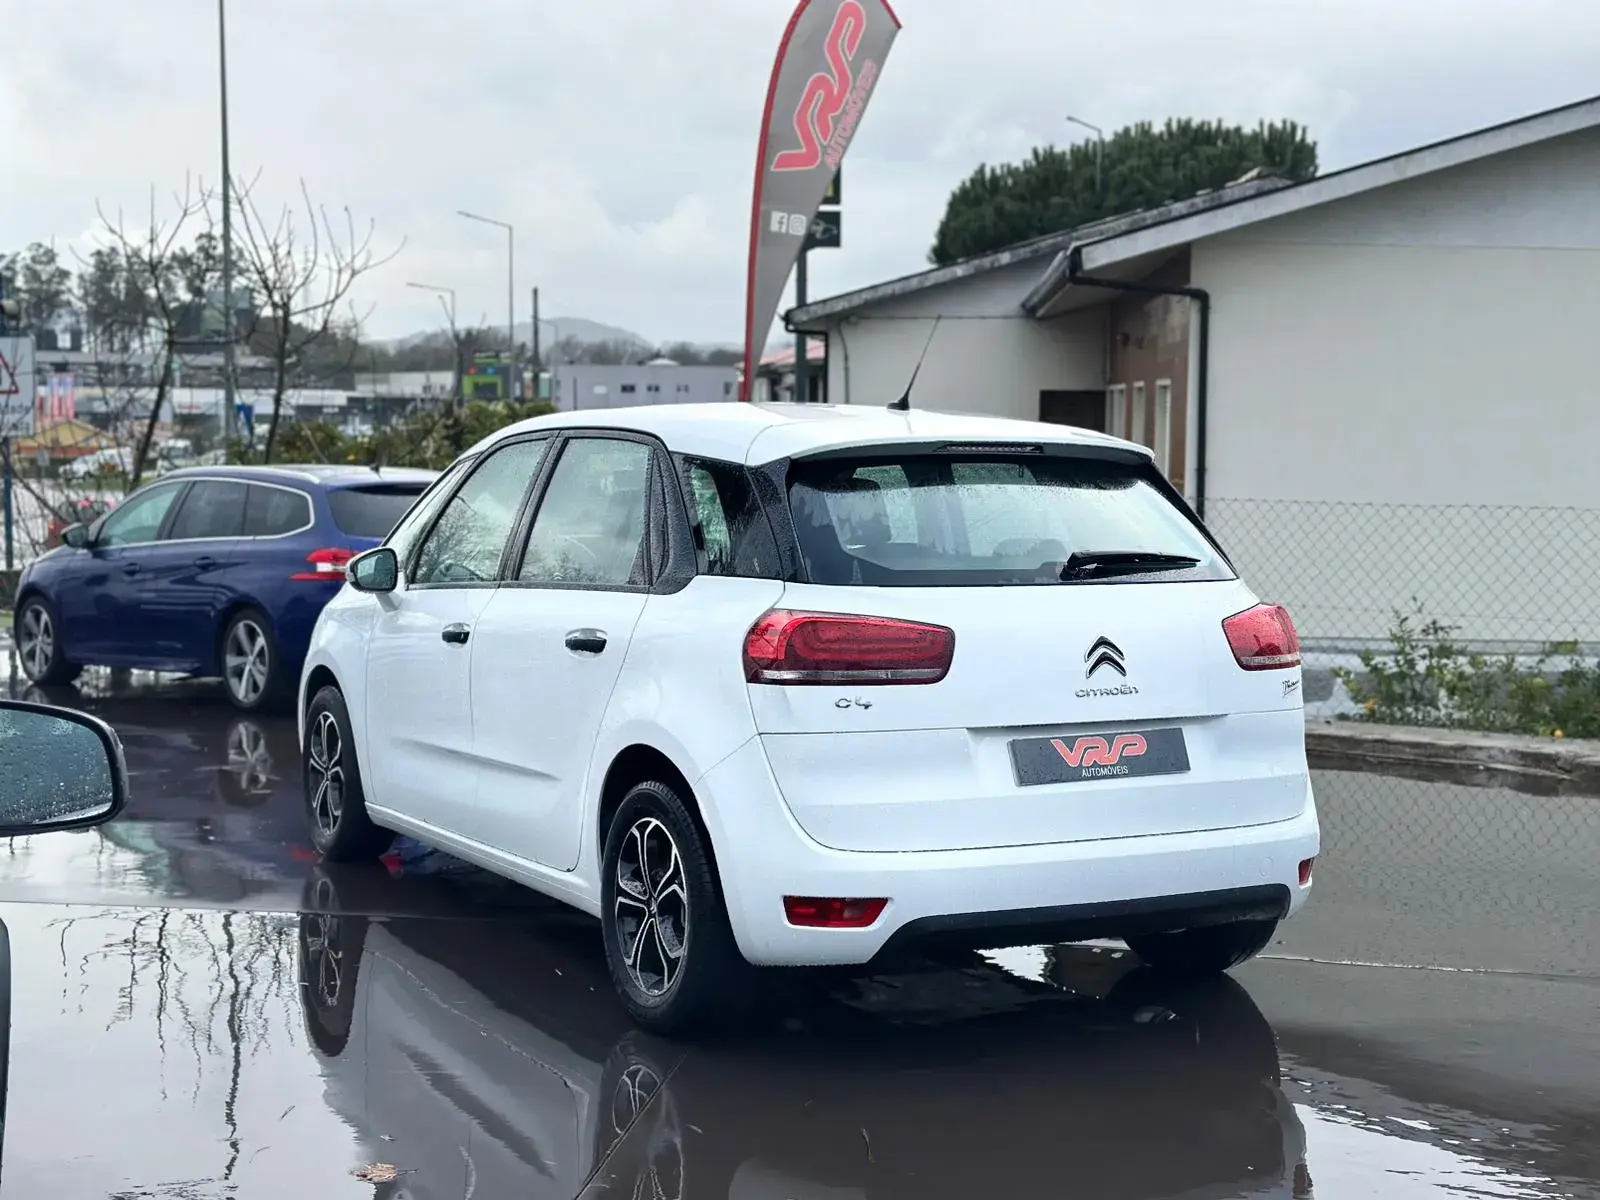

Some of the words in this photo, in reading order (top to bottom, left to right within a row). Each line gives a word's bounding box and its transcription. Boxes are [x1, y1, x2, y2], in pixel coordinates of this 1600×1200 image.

[770, 0, 866, 171] VRP
[834, 696, 873, 710] C4
[1050, 733, 1148, 768] VRP
[1081, 765, 1129, 778] AUTOMÓVEIS
